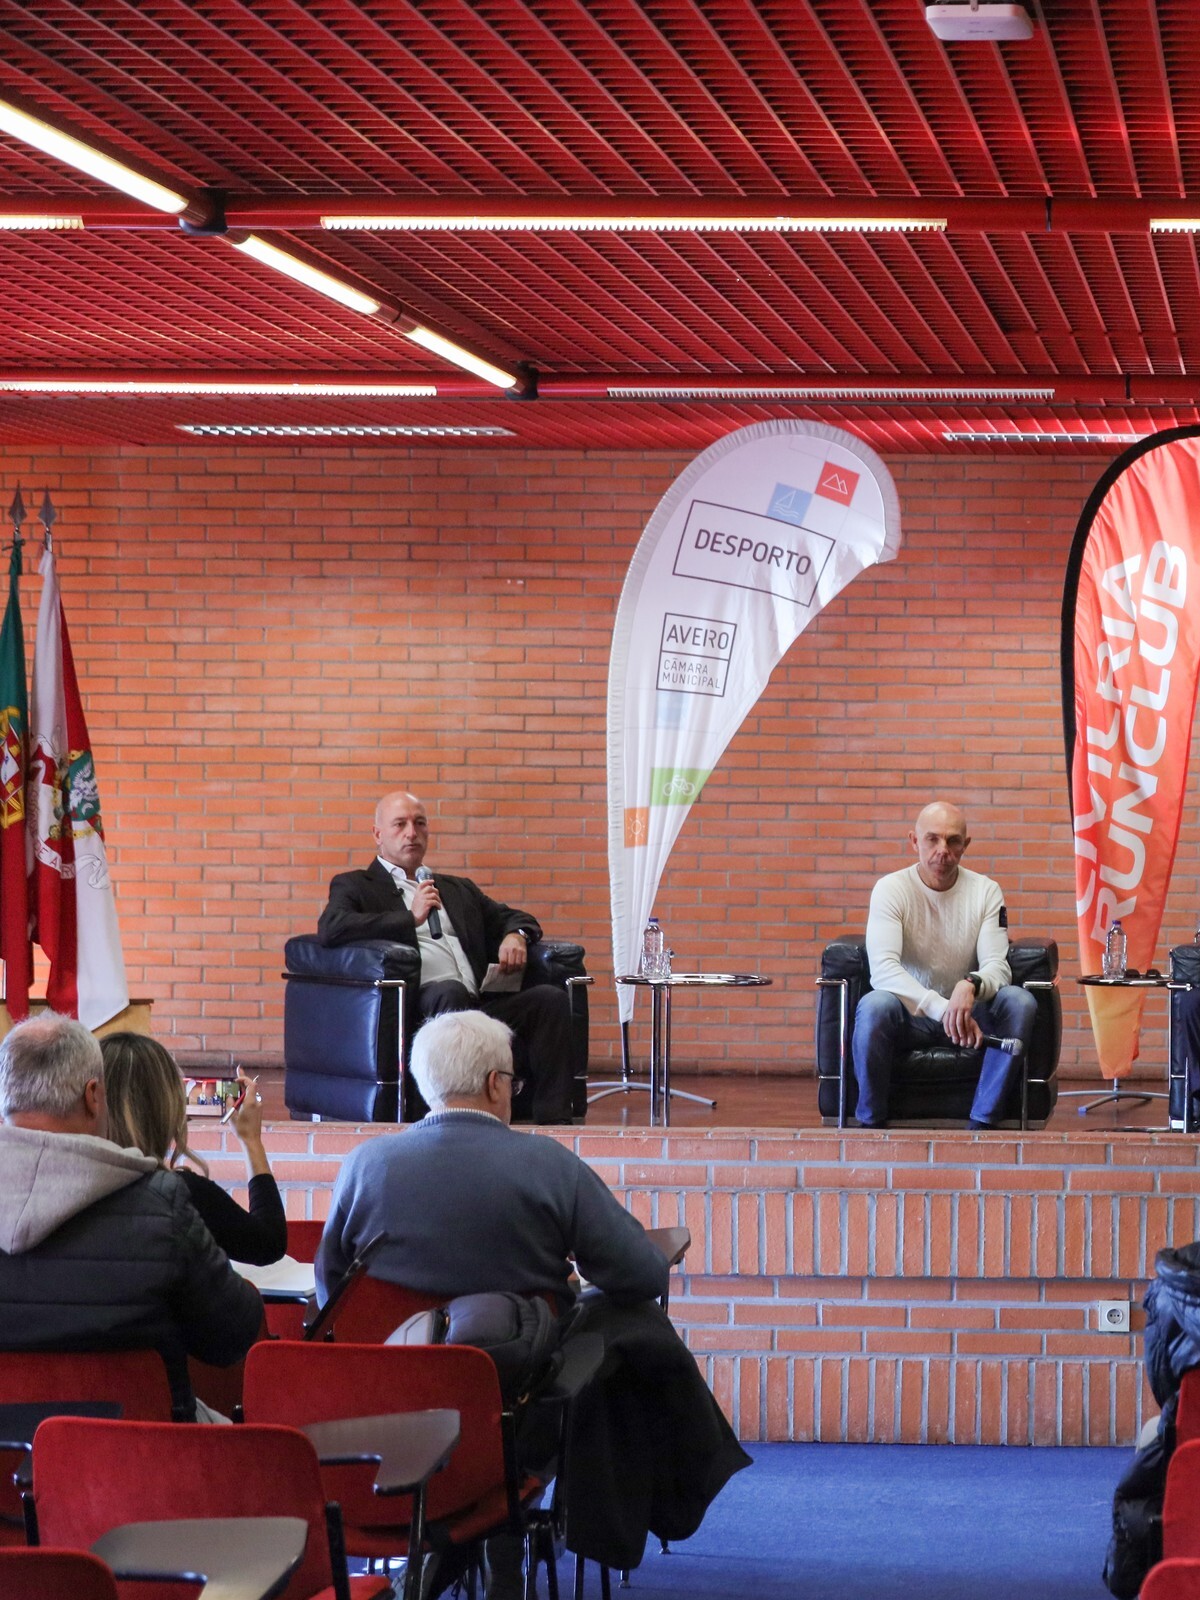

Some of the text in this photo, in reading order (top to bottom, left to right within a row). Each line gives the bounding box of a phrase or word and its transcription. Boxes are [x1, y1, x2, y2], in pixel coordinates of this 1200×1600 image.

[694, 528, 812, 576] DESPORTO
[666, 623, 730, 651] AVEIRO
[662, 671, 721, 690] MUNICIPAL
[1090, 540, 1188, 947] RUNCLUB
